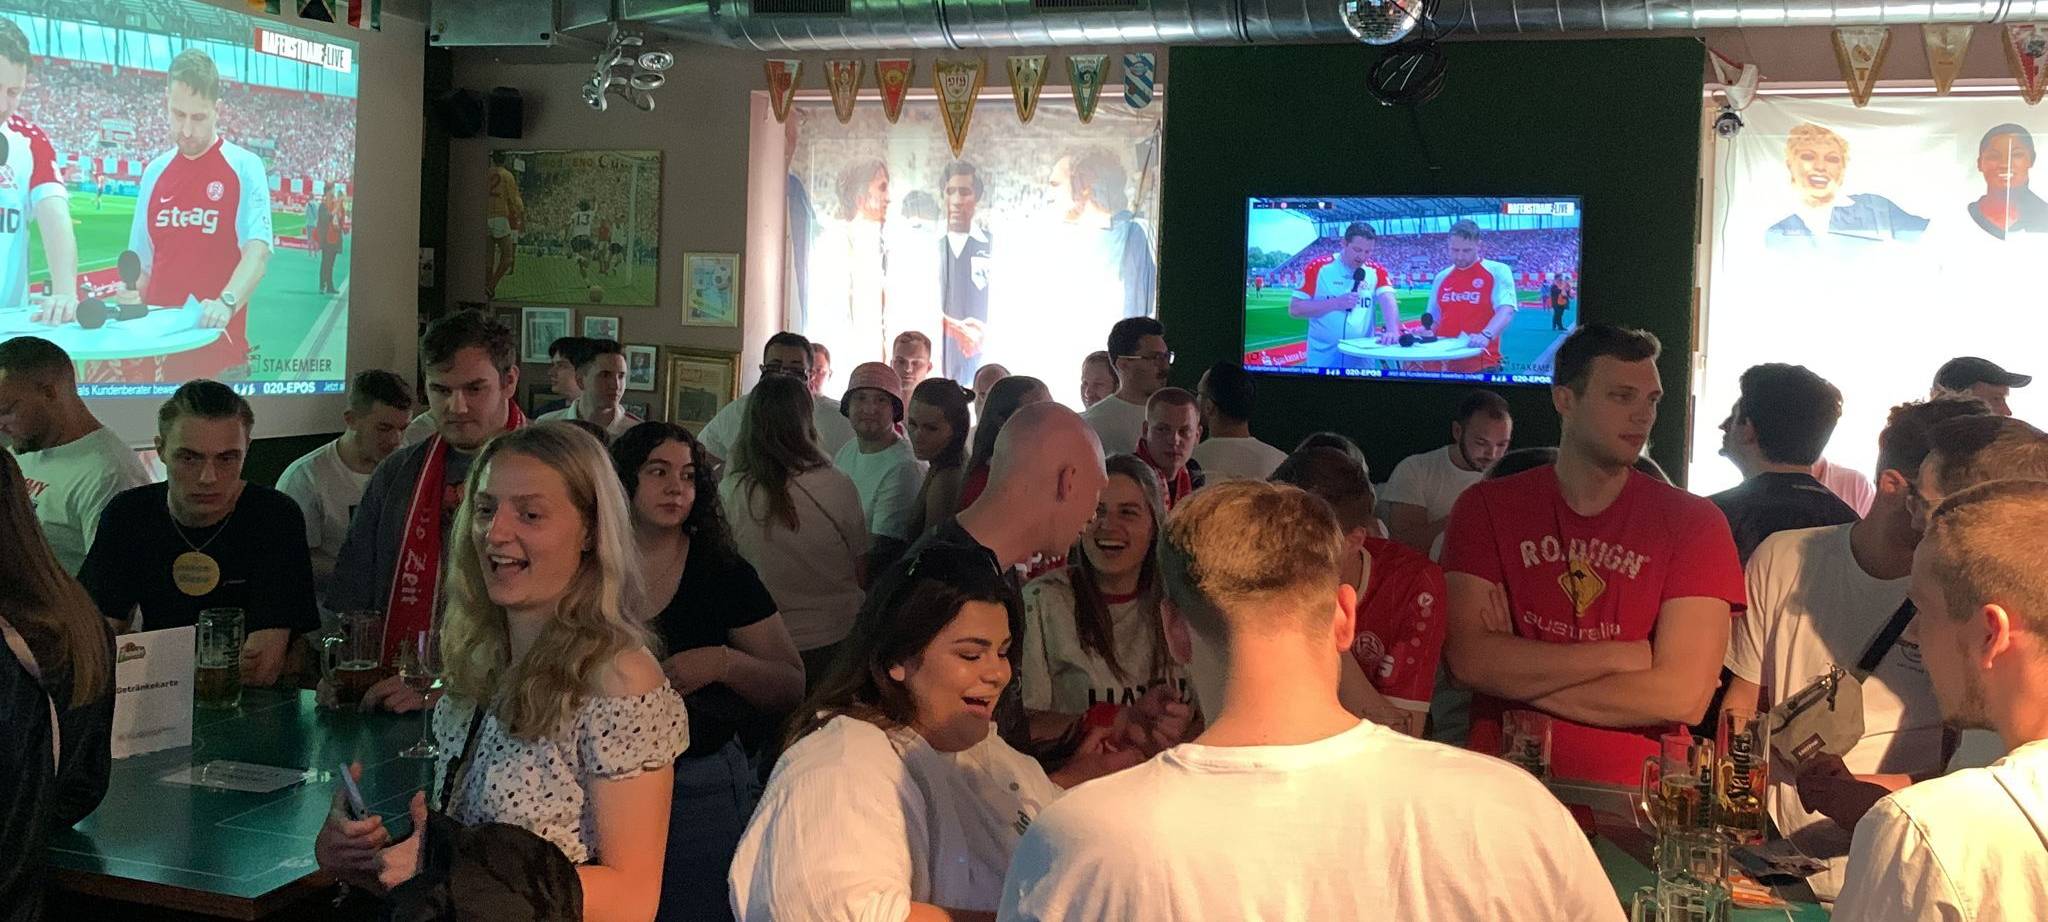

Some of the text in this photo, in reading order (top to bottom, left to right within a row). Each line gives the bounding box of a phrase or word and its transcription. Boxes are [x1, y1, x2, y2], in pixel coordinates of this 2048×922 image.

[155, 206, 219, 234] steag
[576, 213, 590, 226] 13
[262, 358, 332, 374] STAKEMEIER
[91, 384, 152, 396] Kundenberater
[263, 381, 315, 394] 020-EPOS
[401, 547, 428, 606] Zeit
[1523, 610, 1621, 641] australia
